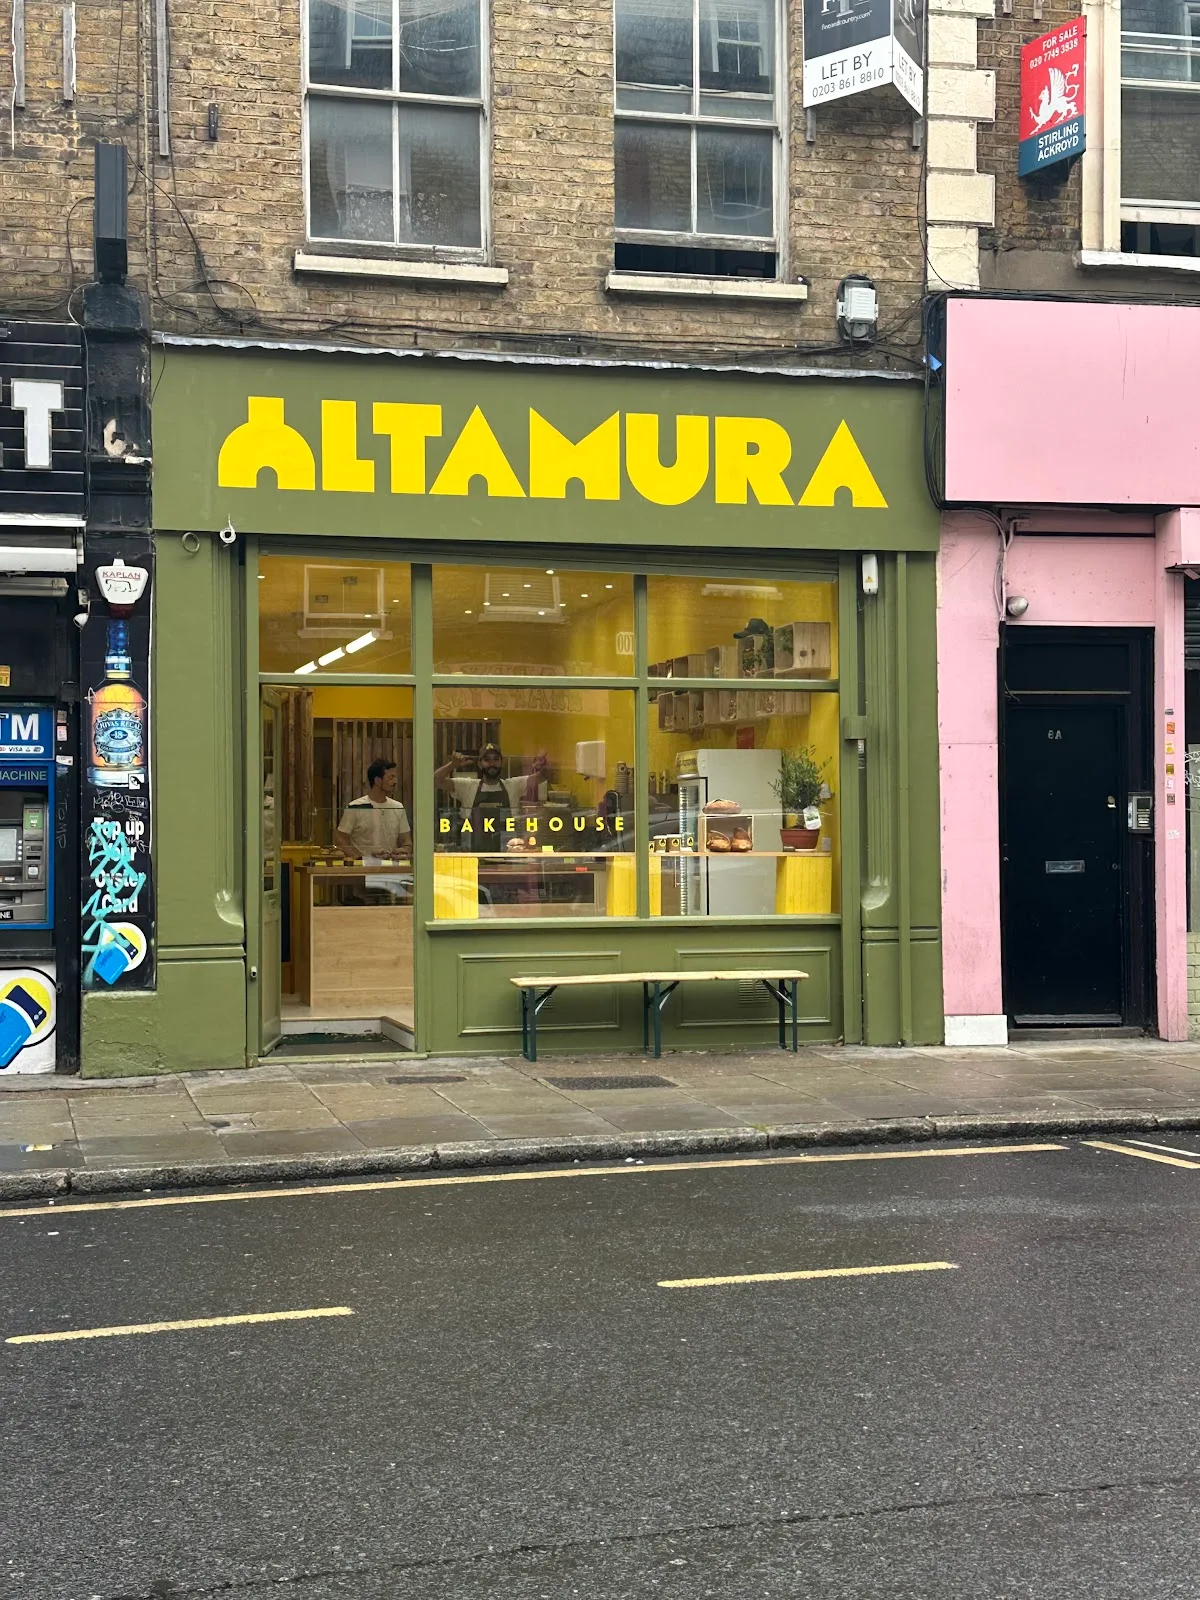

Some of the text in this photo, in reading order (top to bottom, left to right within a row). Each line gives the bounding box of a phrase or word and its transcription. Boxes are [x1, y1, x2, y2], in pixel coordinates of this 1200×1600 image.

[1042, 25, 1078, 51] FOR SALE
[821, 51, 873, 80] LET BY
[1029, 55, 1043, 69] 020
[812, 67, 885, 98] 0203 861 8810
[1037, 122, 1080, 148] STIRLING
[1037, 135, 1080, 162] ACKROYD
[0, 375, 65, 470] T
[217, 396, 889, 508] ALTAMURA
[102, 570, 141, 580] KAPLAN
[0, 770, 47, 780] ACHINE
[125, 820, 145, 841] up
[439, 817, 625, 833] BAKEHOUSE
[101, 893, 139, 914] Card
